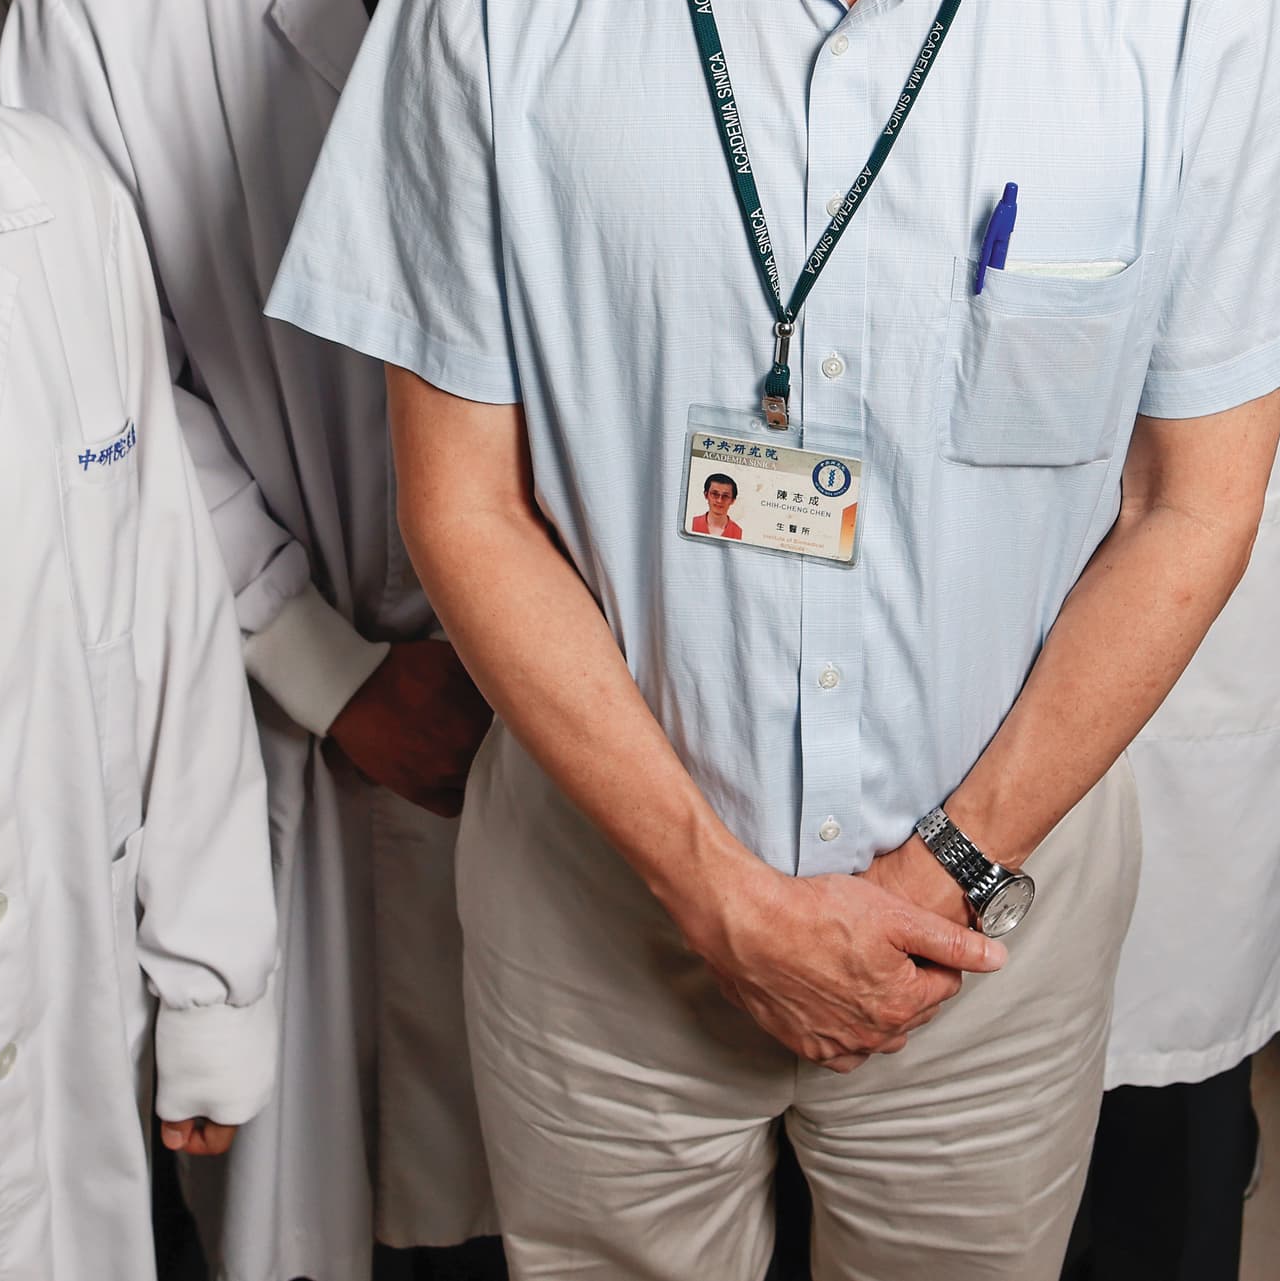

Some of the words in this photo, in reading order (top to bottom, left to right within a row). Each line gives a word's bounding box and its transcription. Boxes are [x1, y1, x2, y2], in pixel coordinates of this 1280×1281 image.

[709, 51, 733, 99] SINICA
[905, 21, 944, 91] ACADEMIA
[721, 100, 752, 174] ACADEMIA
[883, 92, 911, 136] SINICA
[830, 165, 873, 232] ACADEMIA
[750, 207, 771, 255] SINICA
[804, 232, 834, 274] SINICA
[702, 437, 779, 461] 中央研究院
[703, 451, 748, 466] ACADEMIA
[760, 500, 808, 514] CHIH-CHENG
[809, 508, 832, 518] CHEN
